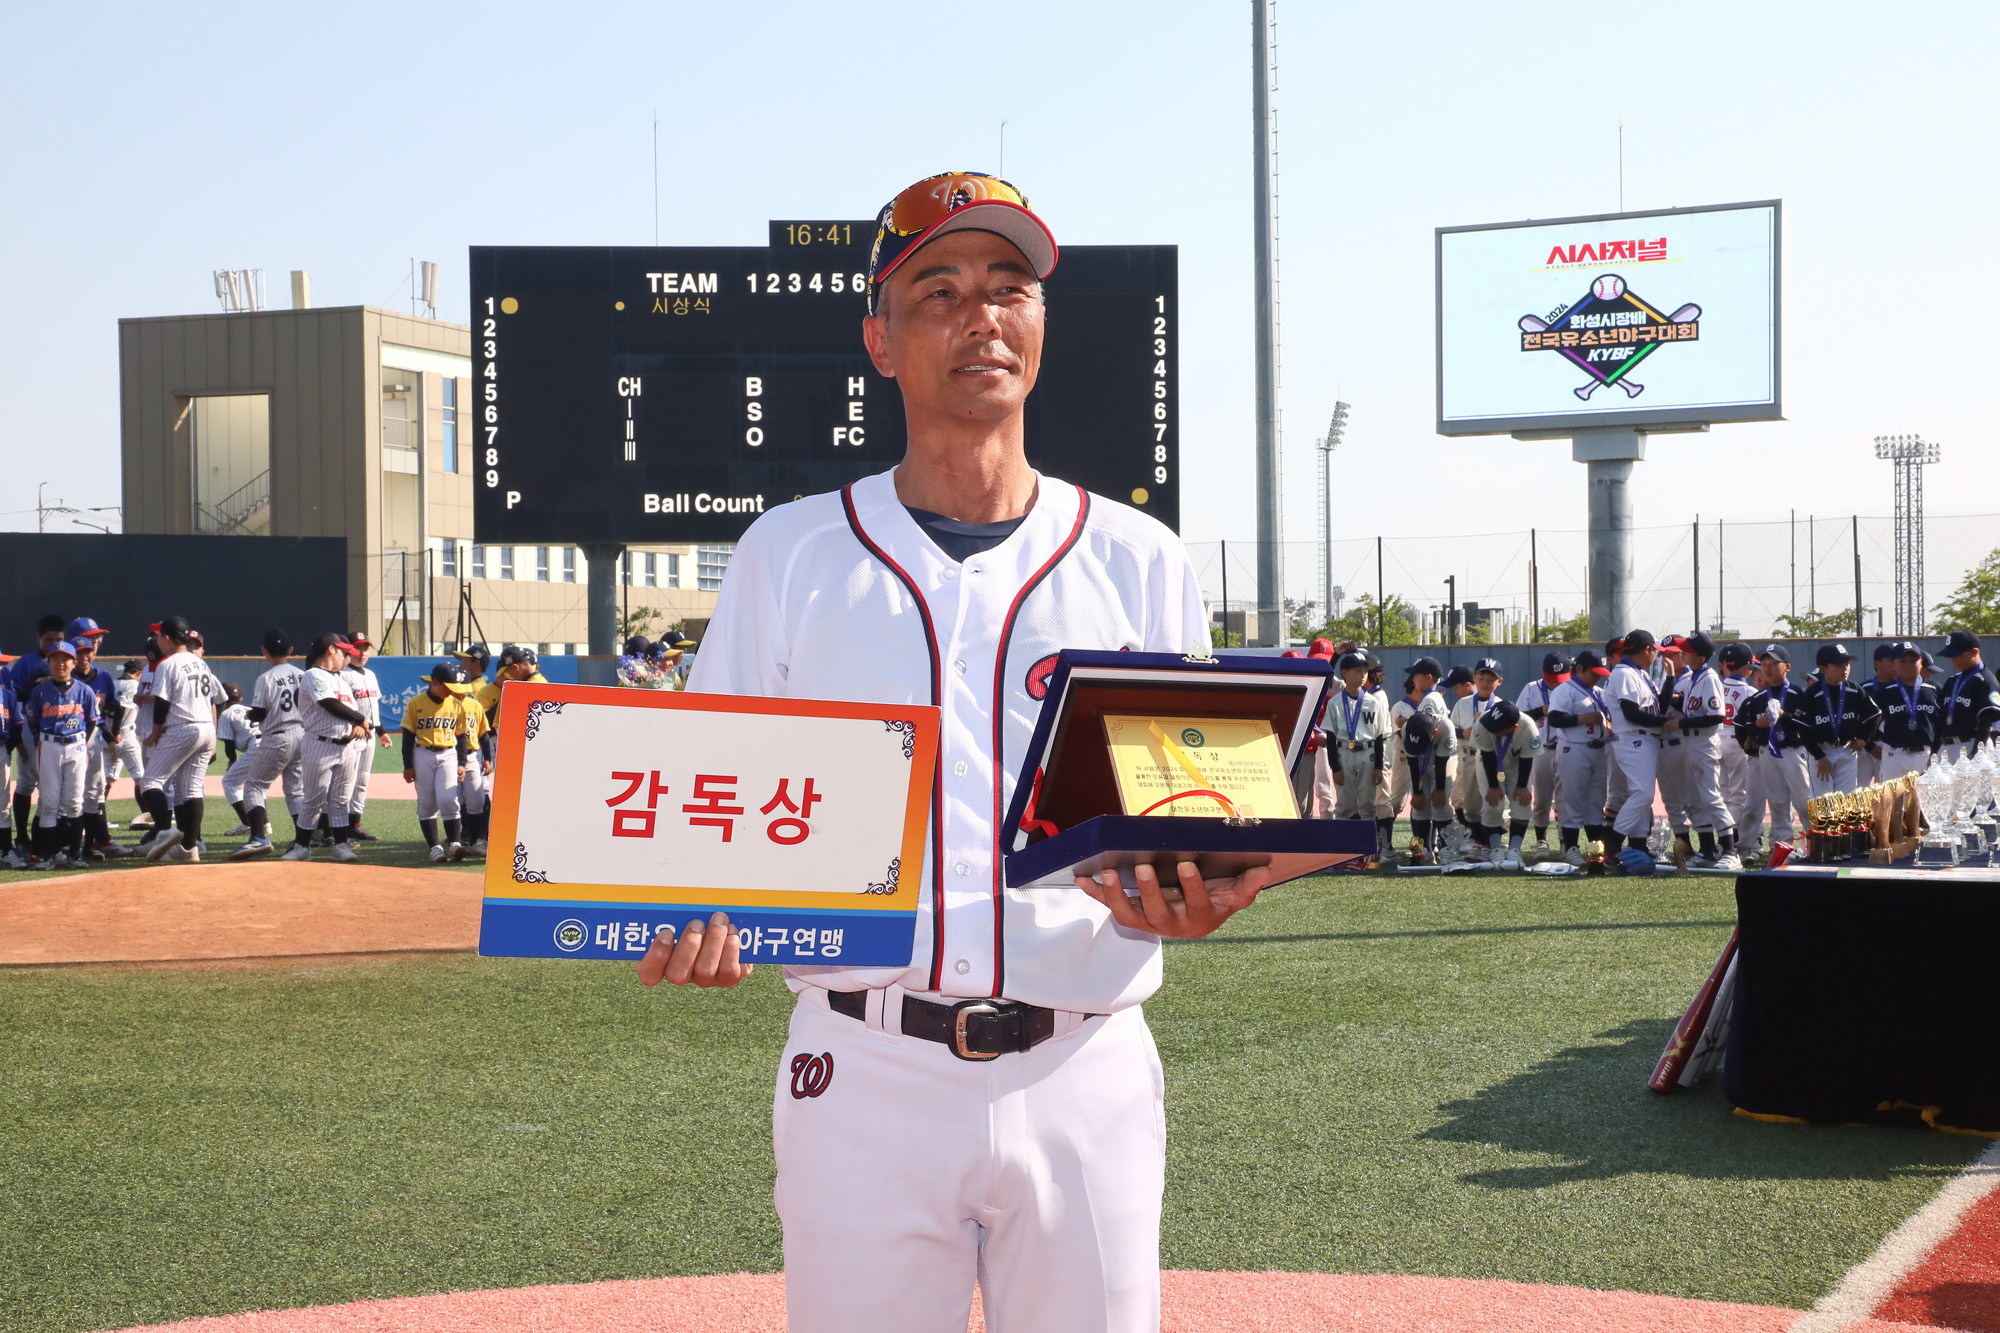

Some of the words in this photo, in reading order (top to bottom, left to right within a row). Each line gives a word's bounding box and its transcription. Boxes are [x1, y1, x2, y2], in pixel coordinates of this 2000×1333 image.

[787, 223, 851, 246] 16:41
[1546, 237, 1666, 264] 시사저널
[646, 273, 718, 293] TEAM
[746, 273, 757, 293] 1
[766, 273, 781, 293] 2
[788, 273, 802, 293] 3
[809, 273, 823, 293] 4
[831, 273, 845, 293] 5
[852, 273, 866, 293] 6
[485, 297, 495, 315] 1
[652, 297, 711, 315] 시상식
[1155, 296, 1165, 314] 1
[1545, 303, 1569, 323] 2024
[484, 319, 497, 337] 2
[1154, 317, 1167, 335] 2
[1570, 311, 1646, 329] 화성시장배
[1523, 323, 1697, 349] 전국유소년야구대회
[484, 340, 497, 358] 3
[1154, 338, 1167, 356] 3
[1586, 347, 1636, 362] KYBF
[484, 362, 498, 380] 4
[1154, 360, 1167, 377] 4
[485, 384, 498, 401] 5
[618, 377, 642, 397] CH
[746, 377, 763, 397] B
[849, 377, 865, 396] H
[1154, 381, 1167, 399] 5
[485, 405, 498, 423] 6
[747, 402, 763, 421] S
[849, 402, 864, 421] E
[1154, 402, 1167, 420] 6
[485, 427, 499, 445] 7
[746, 427, 764, 446] O
[1154, 424, 1167, 441] 7
[486, 448, 499, 466] 8
[1154, 445, 1167, 463] 8
[486, 470, 499, 488] 9
[1155, 466, 1168, 484] 9
[507, 491, 522, 510] P
[644, 494, 690, 513] Ball
[694, 493, 764, 513] Count
[1836, 643, 1848, 654] B
[1903, 641, 1913, 649] B
[1484, 658, 1497, 669] W
[188, 674, 211, 698] 78
[1363, 712, 1376, 725] W
[1409, 733, 1420, 744] W
[605, 769, 823, 845] 감독상
[1171, 805, 1223, 814] 대한유소년야구연
[594, 922, 844, 957] 대한야구연맹
